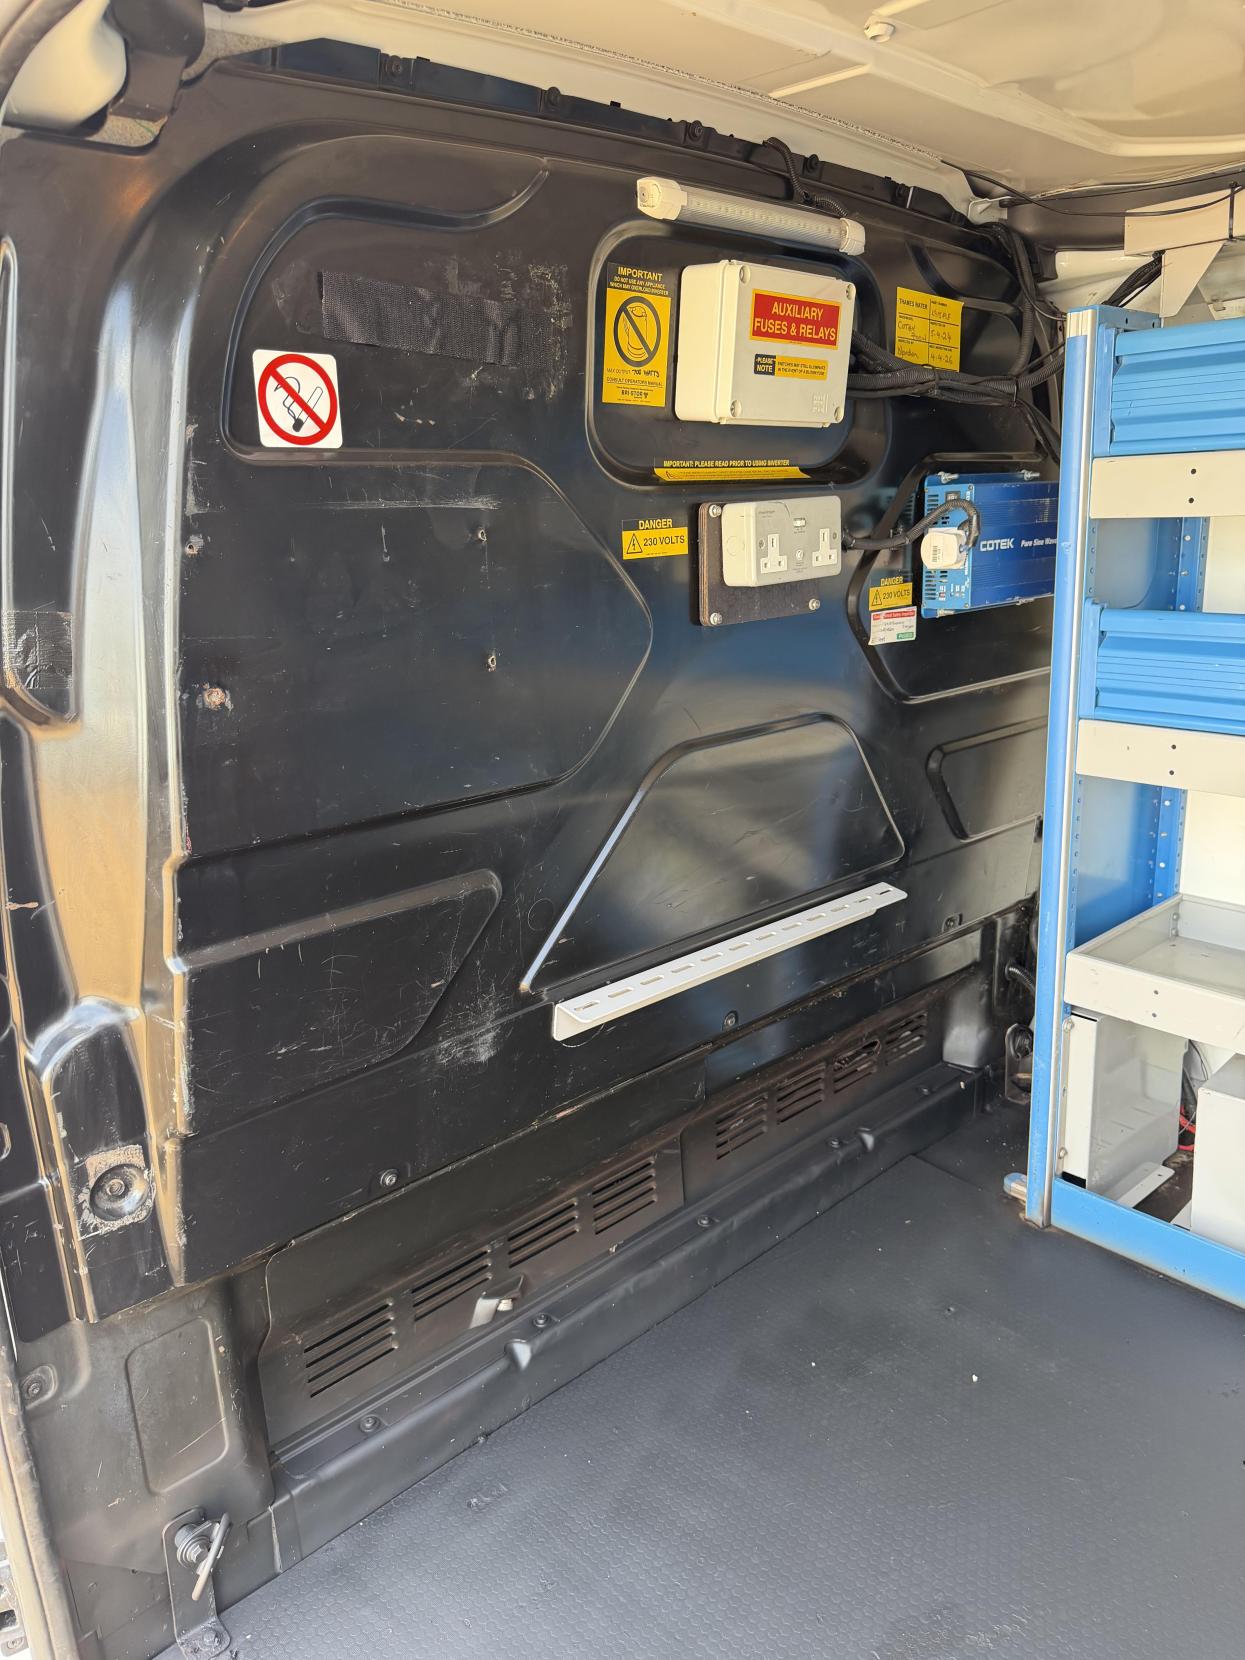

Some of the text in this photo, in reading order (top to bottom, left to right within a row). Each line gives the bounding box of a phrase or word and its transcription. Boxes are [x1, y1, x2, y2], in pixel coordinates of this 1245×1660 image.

[617, 266, 663, 282] IMPORTANT
[771, 301, 824, 321] AUXILIARY
[754, 317, 836, 341] FUSES & RELAYS
[757, 356, 774, 364] PLEASE
[756, 364, 773, 373] NOTE
[638, 518, 673, 530] DANGER
[643, 535, 685, 547] 230 VOLTS
[980, 538, 1015, 552] COTEK
[1020, 540, 1033, 548] Pure
[1033, 538, 1044, 546] Sine
[880, 576, 904, 586] DANGER
[882, 589, 911, 600] 230 VOLTS
